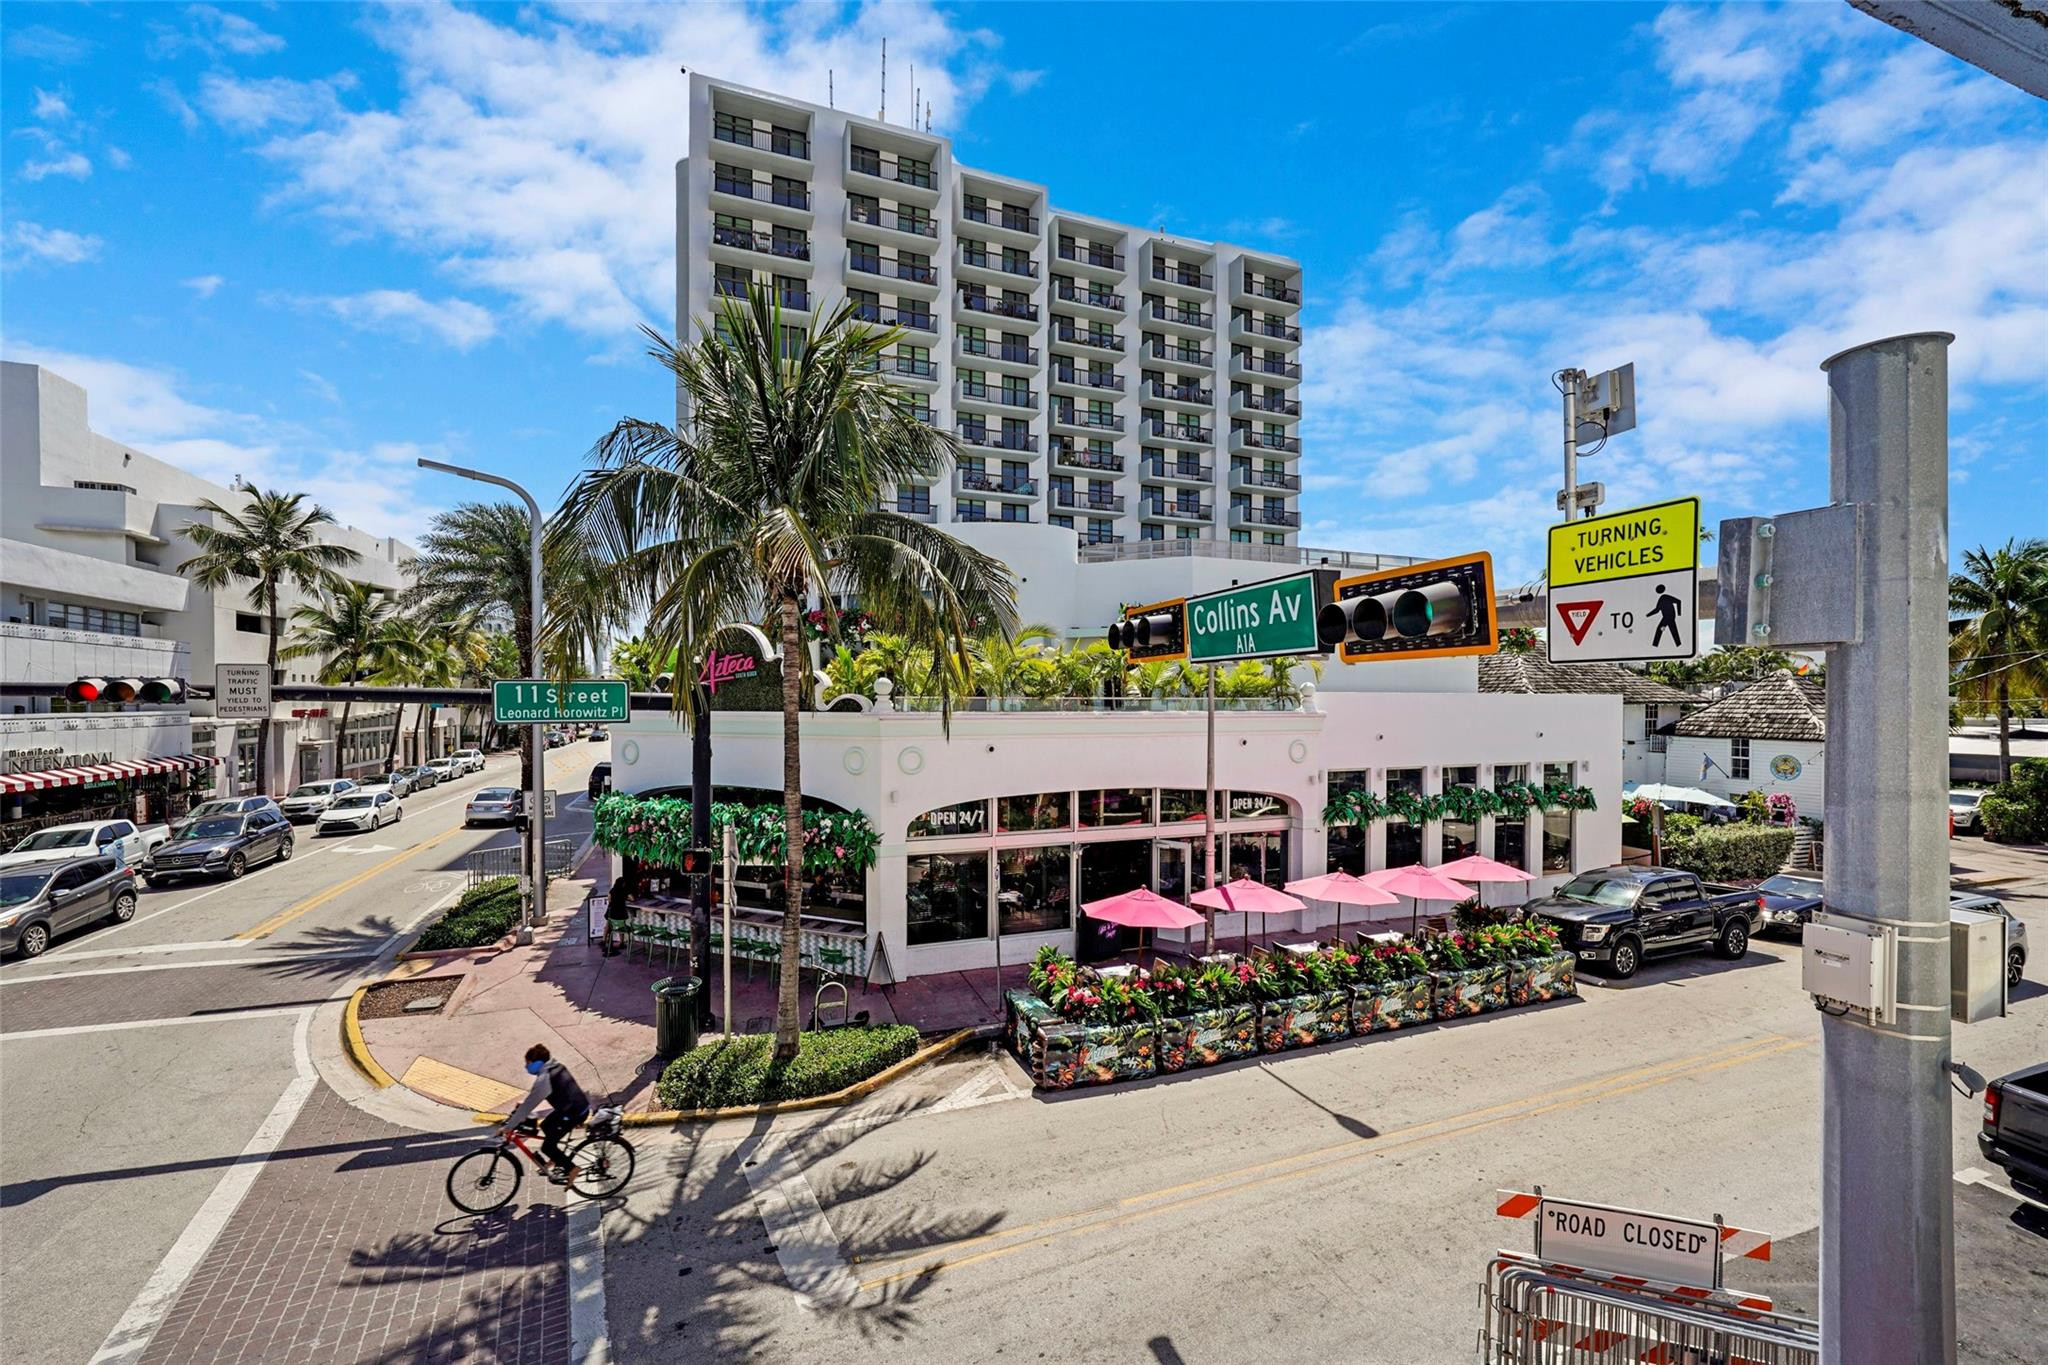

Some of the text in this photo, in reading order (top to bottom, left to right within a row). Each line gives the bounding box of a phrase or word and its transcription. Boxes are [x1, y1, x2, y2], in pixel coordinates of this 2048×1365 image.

[1578, 518, 1661, 548] TURNING
[1575, 546, 1664, 574] VEHICLES
[1194, 589, 1302, 635] Collins Av
[1610, 611, 1634, 630] TO
[1236, 632, 1257, 654] A1A
[699, 649, 756, 695] Azteca
[229, 687, 257, 695] MUST
[515, 685, 608, 704] 11 Sreet
[219, 705, 268, 713] PEDESTRIANS
[500, 707, 550, 719] Leonard
[555, 707, 607, 718] Horowitz
[1232, 797, 1253, 811] OPEN
[930, 809, 985, 827] OPEN 24/7
[1556, 1211, 1702, 1255] ROAD CLOSED
